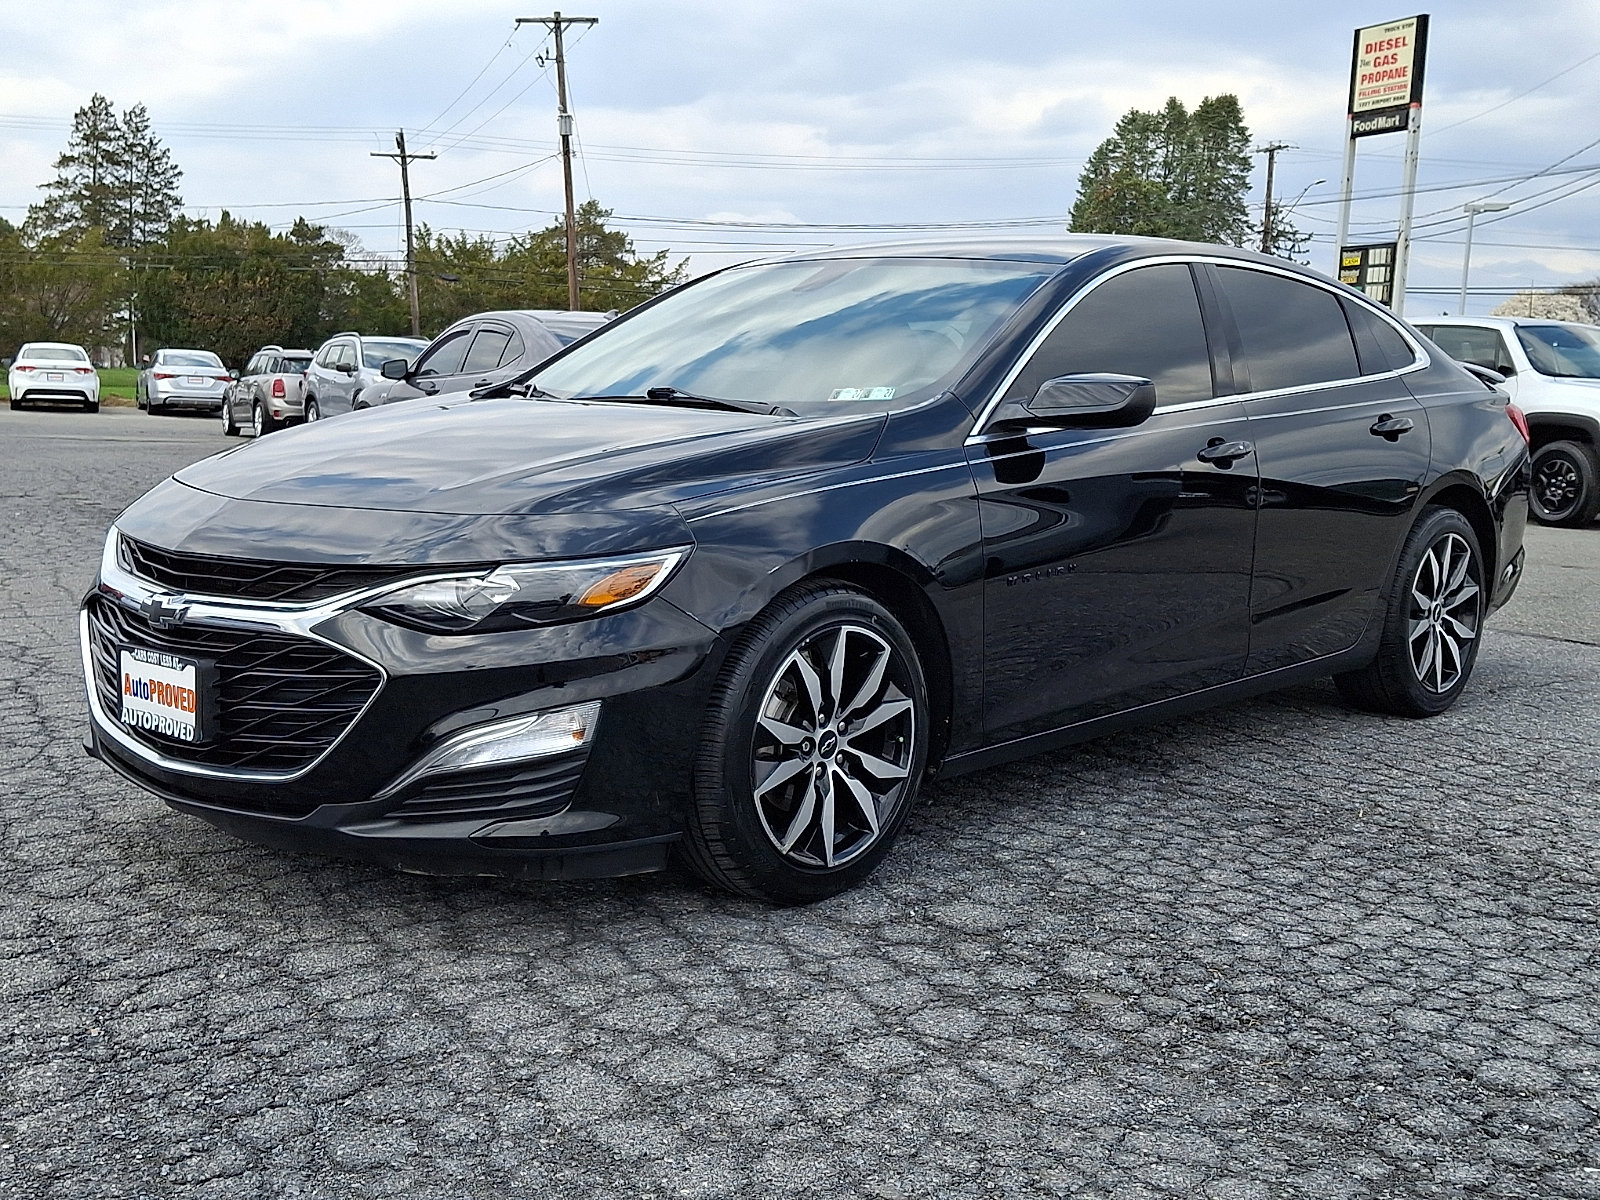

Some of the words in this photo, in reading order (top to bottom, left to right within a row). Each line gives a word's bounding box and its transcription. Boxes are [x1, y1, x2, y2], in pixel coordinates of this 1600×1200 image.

[1365, 36, 1408, 54] DIESEL
[1374, 53, 1398, 68] GAS
[1361, 66, 1408, 85] PROPANE
[1383, 84, 1408, 93] STATION
[1372, 97, 1392, 105] AIRPORT
[147, 651, 160, 665] COST
[160, 654, 173, 668] LESS
[124, 673, 196, 713] AutoPROVED
[121, 707, 194, 741] AUTOPROVED
